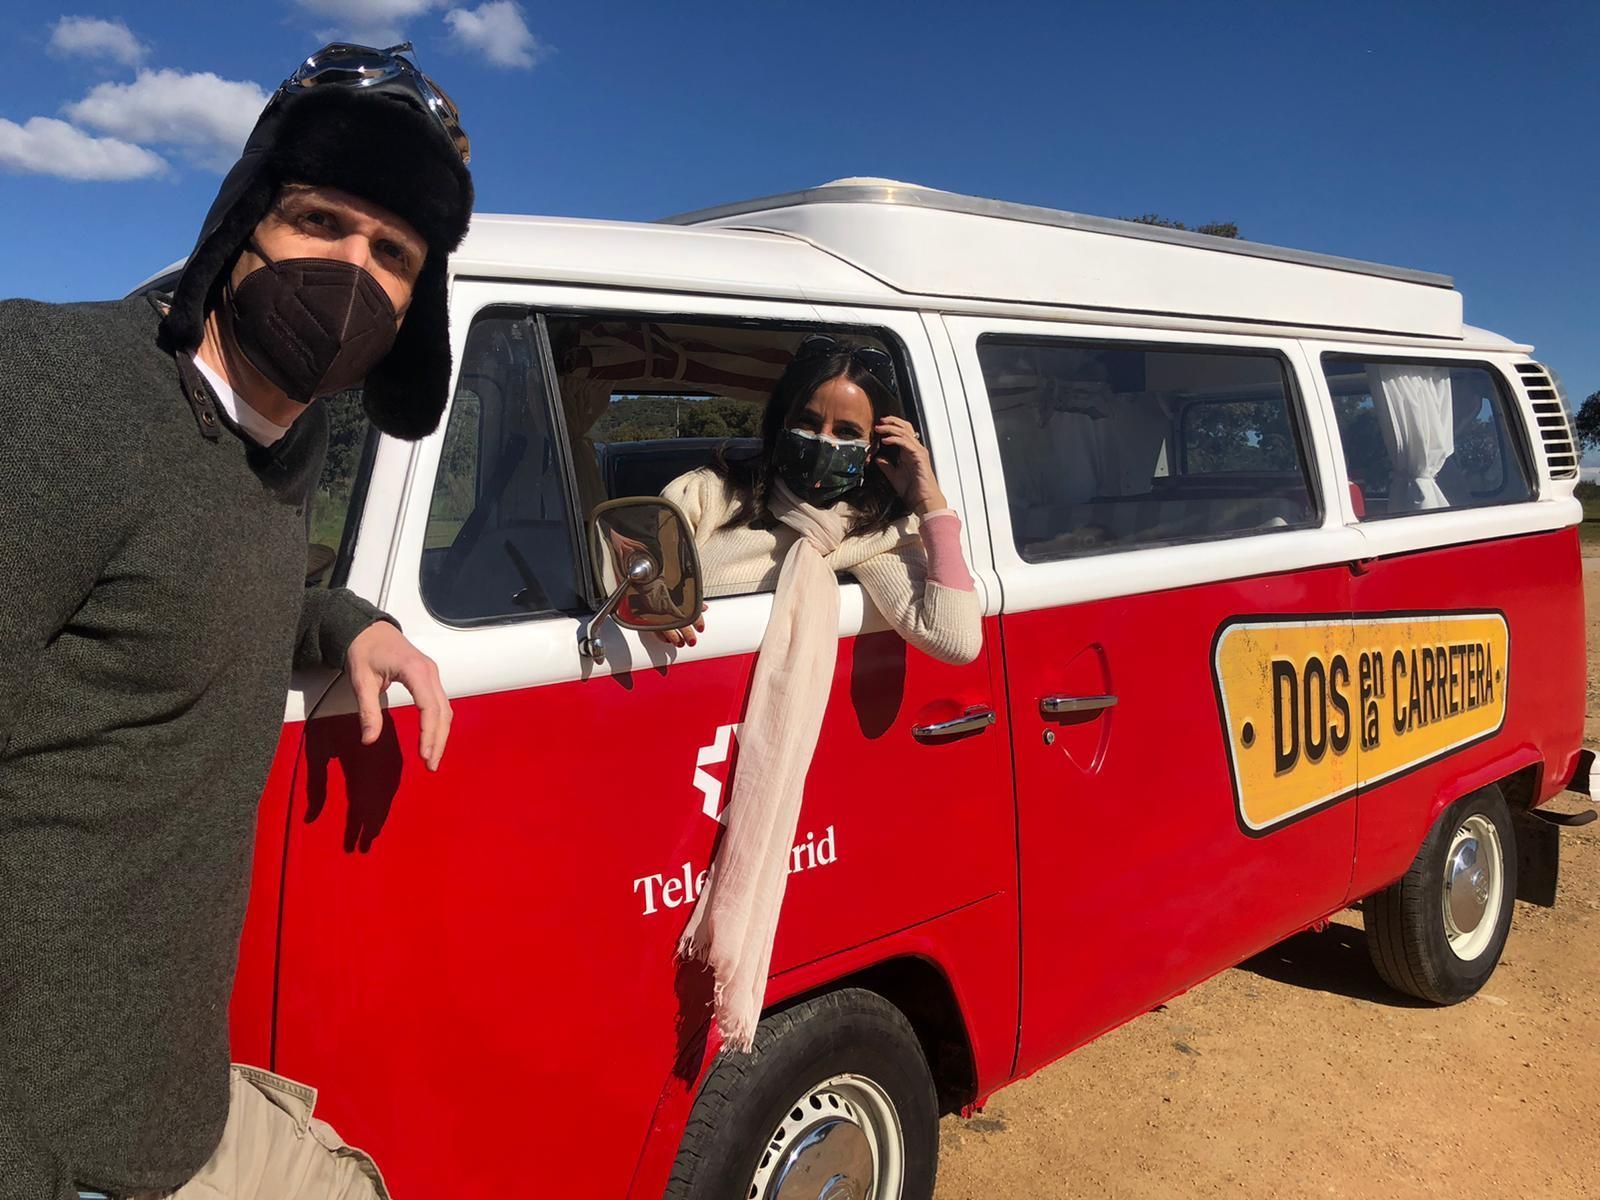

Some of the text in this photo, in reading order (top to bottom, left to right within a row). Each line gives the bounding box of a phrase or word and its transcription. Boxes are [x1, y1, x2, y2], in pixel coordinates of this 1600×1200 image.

[1271, 642, 1495, 776] DOS en la CARRETERA
[633, 825, 838, 916] Telerid
